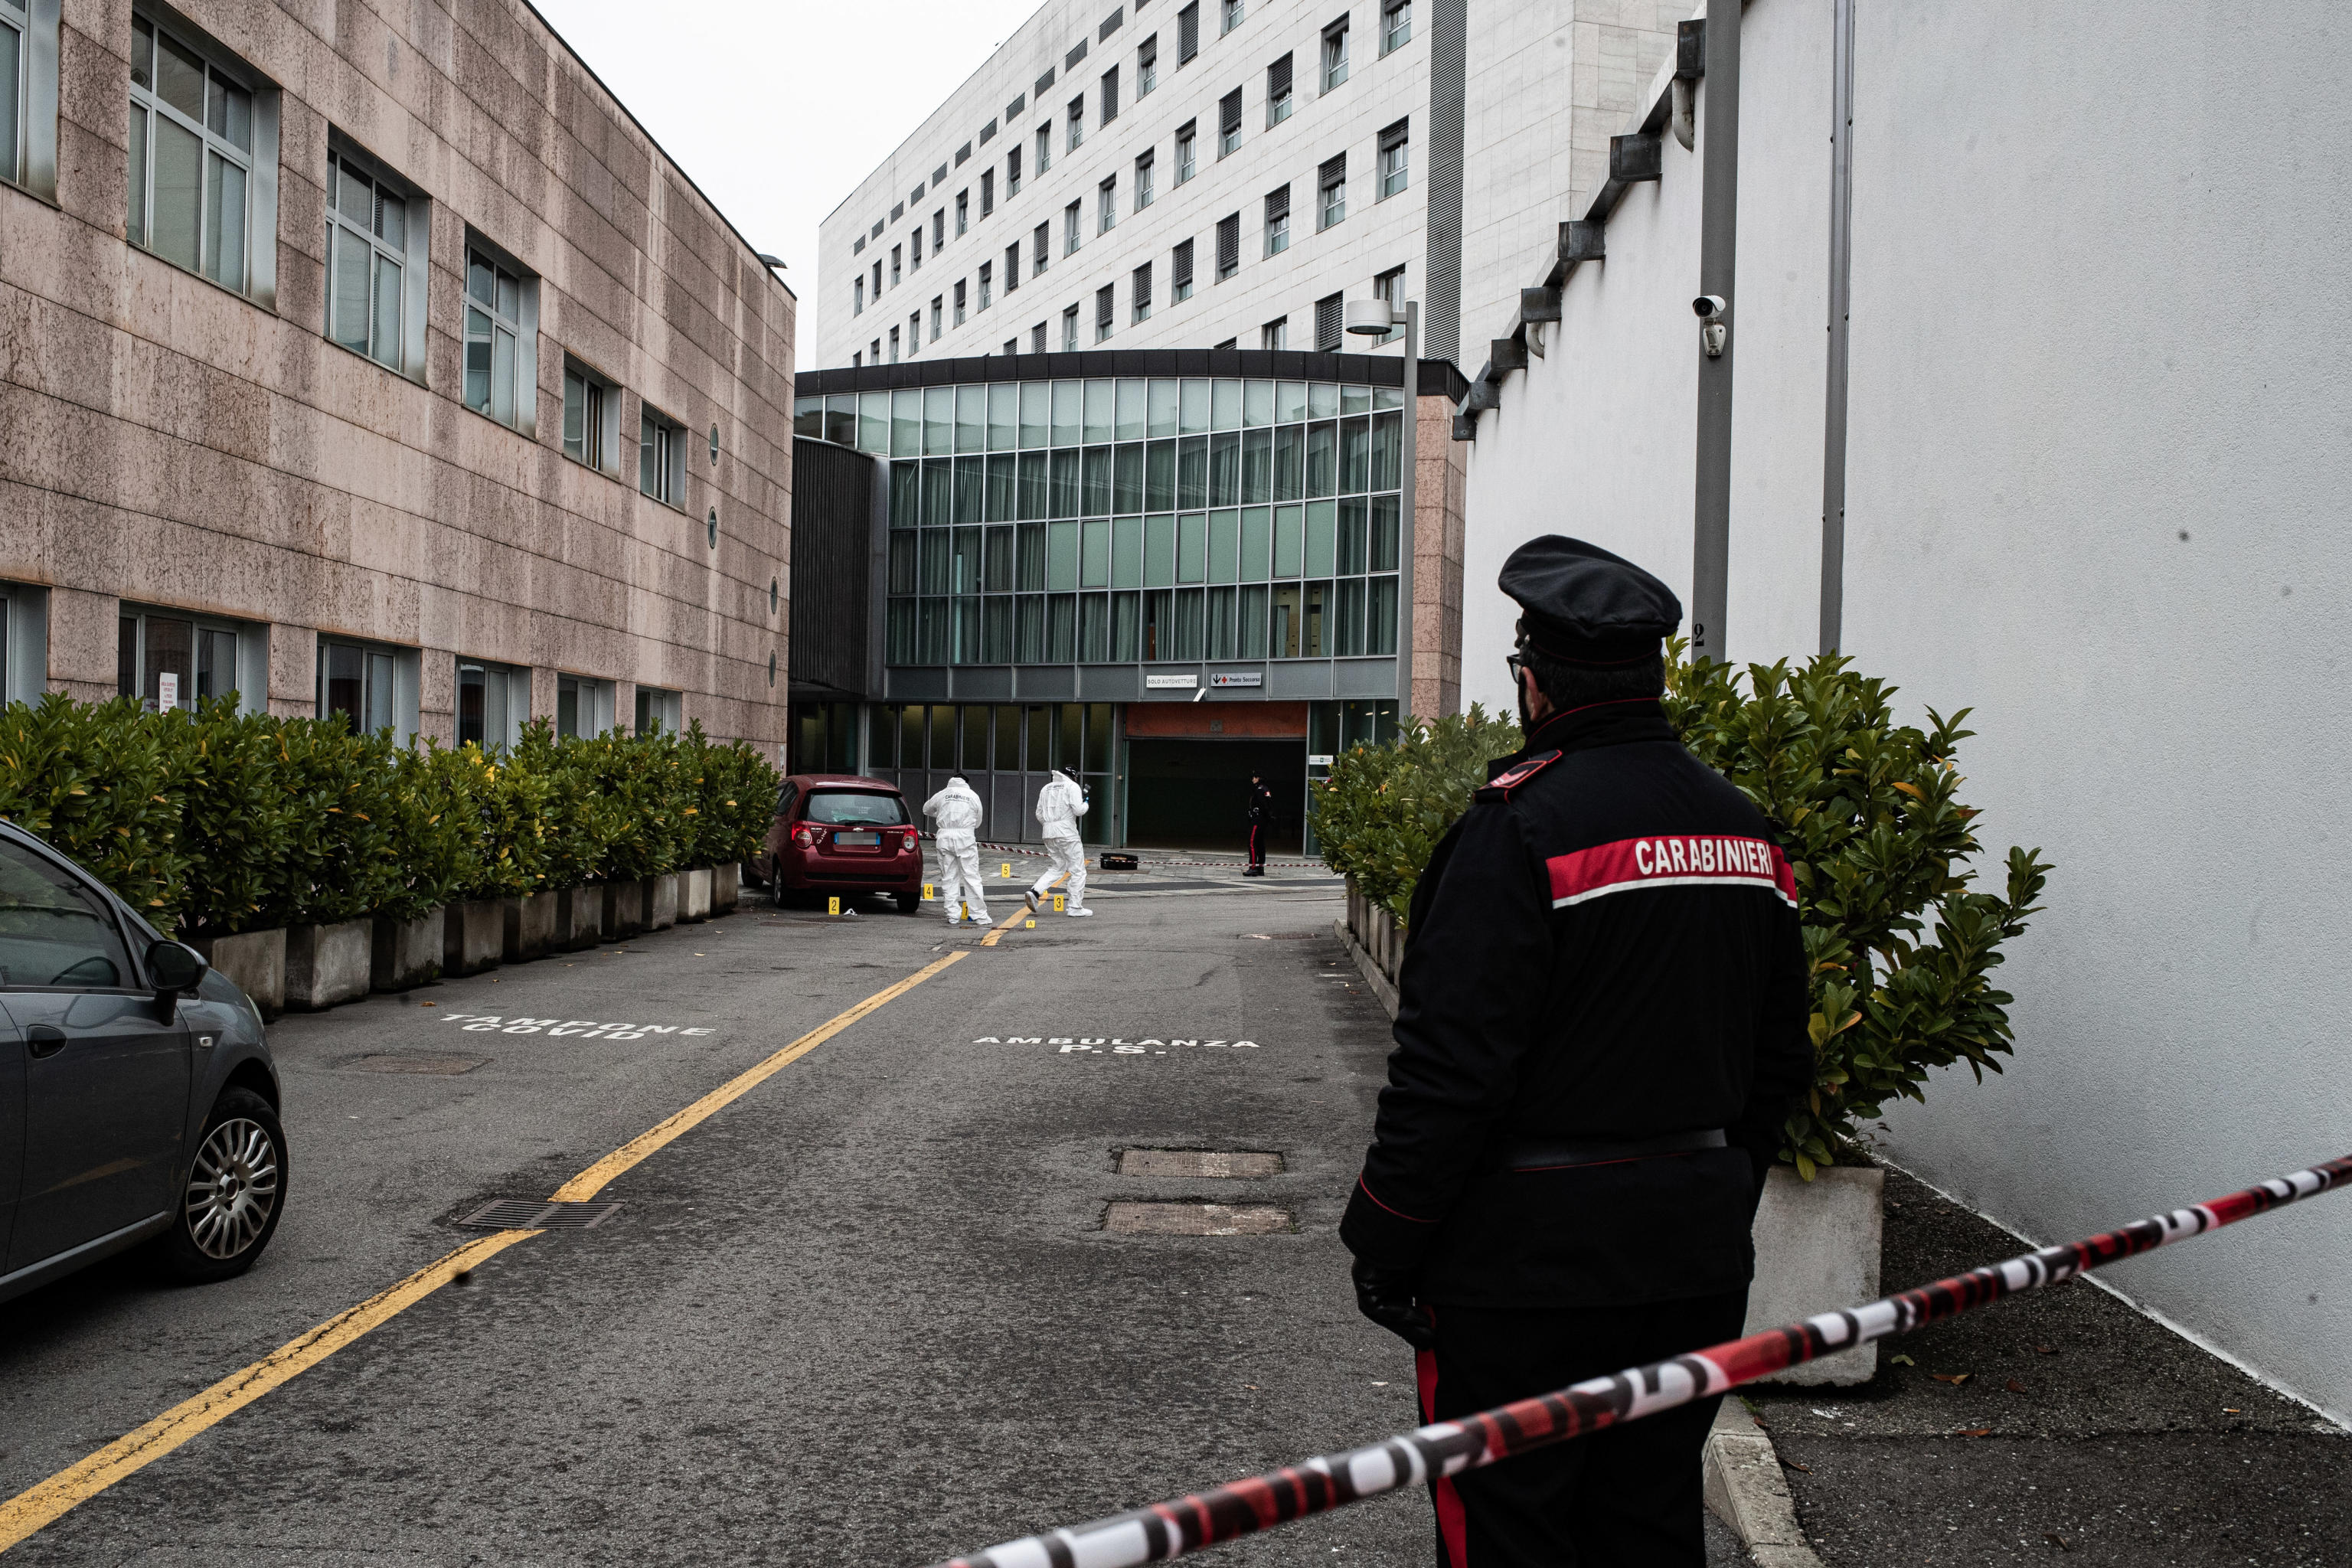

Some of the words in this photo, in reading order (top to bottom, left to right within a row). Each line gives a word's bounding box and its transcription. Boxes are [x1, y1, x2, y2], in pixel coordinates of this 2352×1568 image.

[1694, 623, 1704, 647] 2
[1635, 838, 1774, 876] CARABINIERI
[831, 900, 837, 911] 2
[1056, 898, 1061, 908] 3
[439, 1014, 718, 1037] TAMPONE
[461, 1023, 645, 1040] COVID
[972, 1037, 1260, 1047] AMBULANZA
[1058, 1044, 1167, 1054] P.S.
